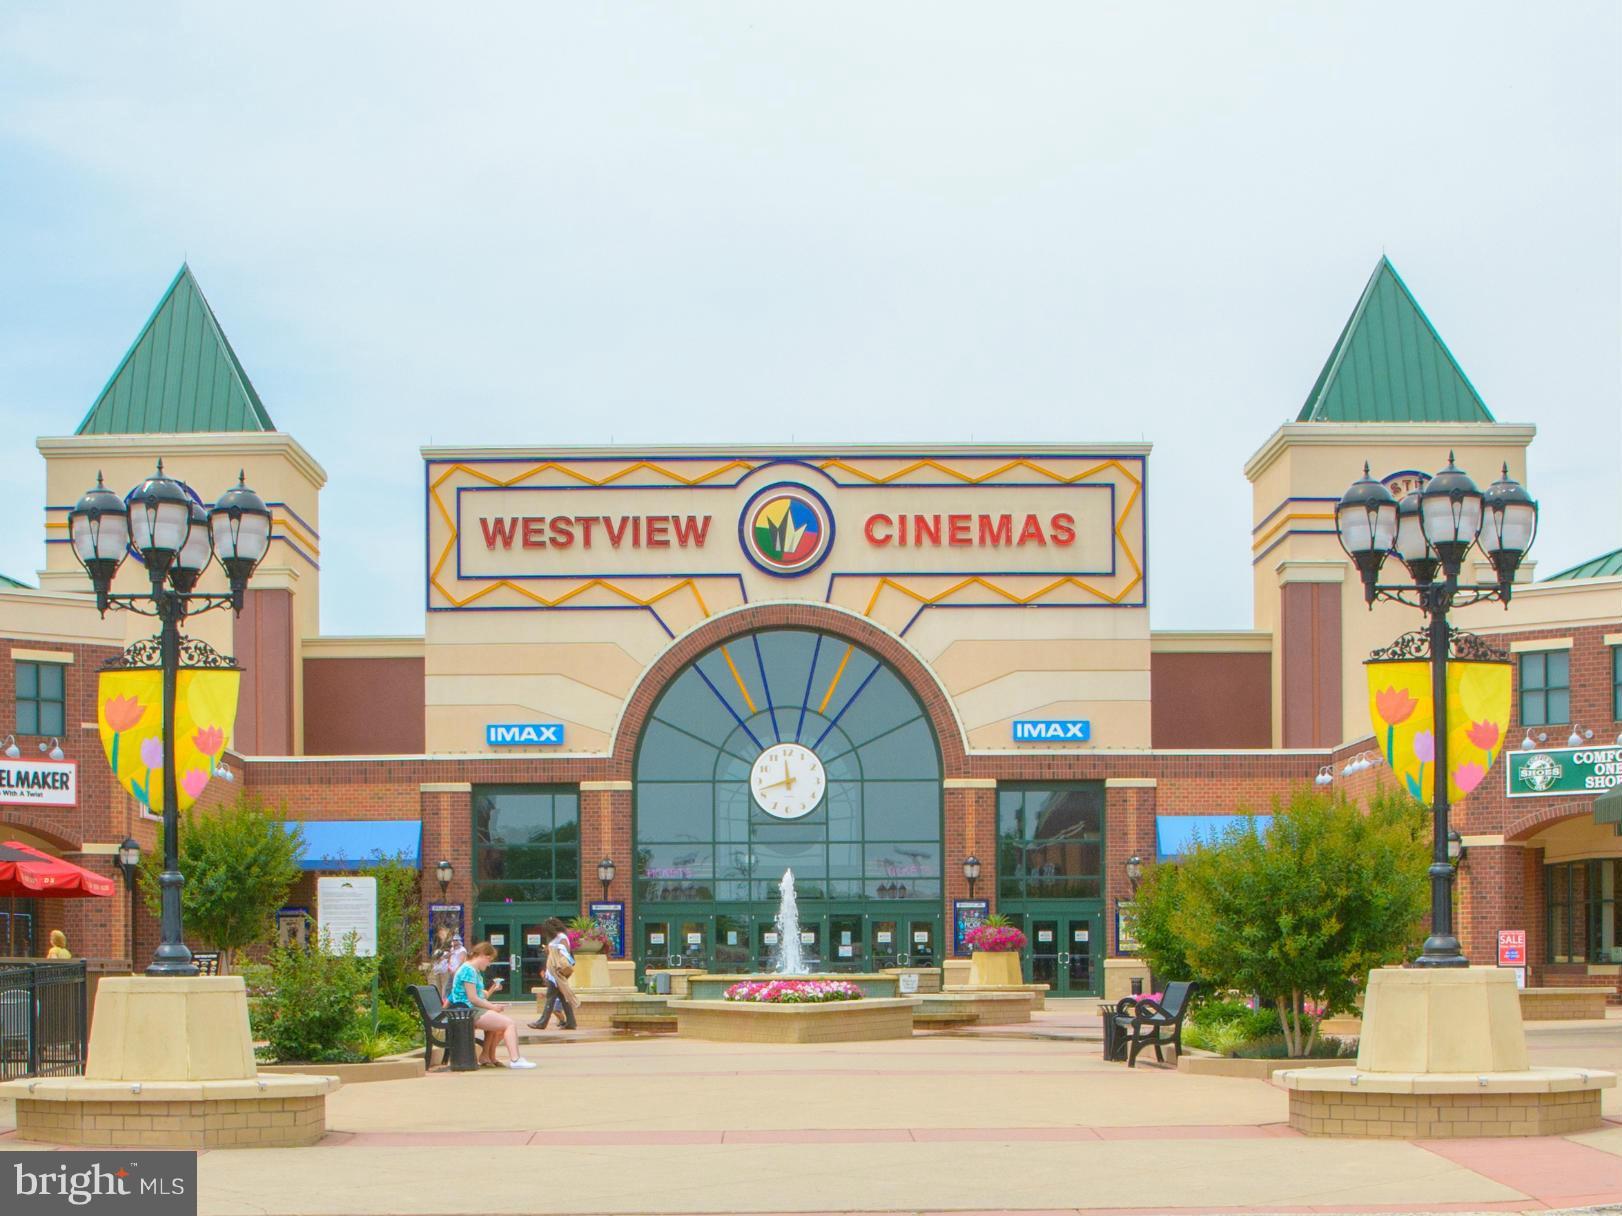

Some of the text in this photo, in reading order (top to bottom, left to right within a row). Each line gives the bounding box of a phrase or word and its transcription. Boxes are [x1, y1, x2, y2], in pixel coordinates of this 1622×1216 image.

[479, 513, 1077, 550] WESTVIEW CINEMAS
[490, 727, 557, 742] IMAX
[1016, 723, 1084, 738] IMAX
[0, 769, 70, 791] ELMAKER
[1500, 935, 1523, 945] SALE
